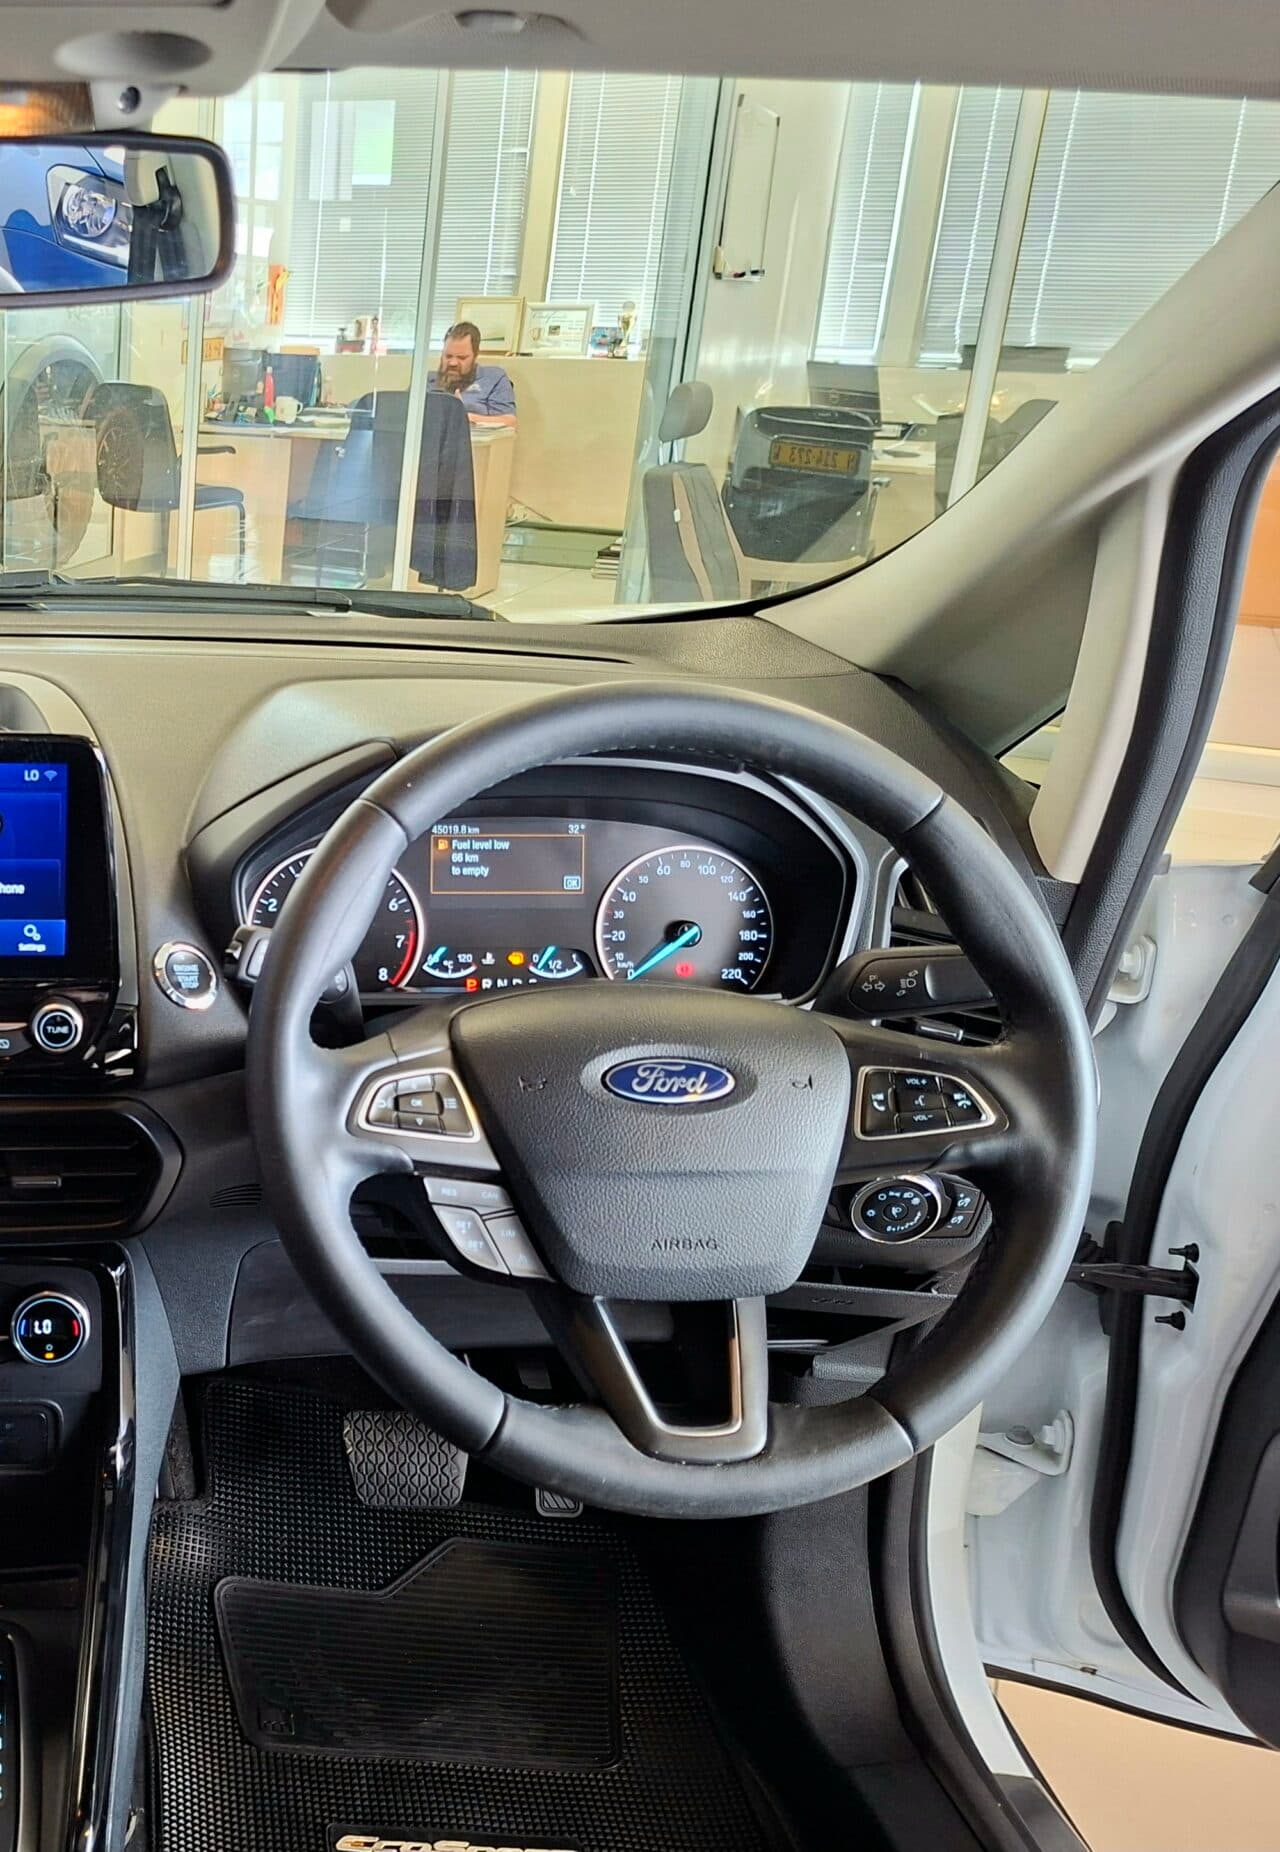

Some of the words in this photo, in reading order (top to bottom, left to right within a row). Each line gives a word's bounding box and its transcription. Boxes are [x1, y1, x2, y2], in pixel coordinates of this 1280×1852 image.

[24, 769, 40, 781] LO
[431, 825, 467, 835] 45019.8
[451, 839, 471, 850] Fuel
[472, 839, 492, 850] level
[494, 839, 510, 850] low
[465, 852, 479, 862] km
[680, 859, 691, 869] 80
[451, 866, 461, 876] to
[462, 866, 489, 877] empty
[657, 865, 671, 876] 60
[698, 865, 717, 876] 100
[639, 875, 649, 884] 50
[721, 876, 734, 884] 120
[622, 891, 637, 903] 40
[728, 891, 747, 902] 140
[268, 898, 277, 912] 2
[388, 901, 399, 912] 6
[613, 911, 625, 920] 30
[742, 911, 756, 920] 160
[395, 935, 406, 948] 7
[611, 930, 626, 942] 20
[739, 930, 759, 942] 180
[457, 953, 473, 963] 120
[738, 952, 754, 962] 200
[548, 960, 562, 969] 1/2
[378, 967, 389, 981] 8
[721, 968, 743, 980] 220
[466, 979, 477, 991] P
[482, 979, 492, 989] R
[46, 1025, 70, 1034] TUNE
[631, 1063, 708, 1095] Ford
[651, 1239, 719, 1251] AIRBAG
